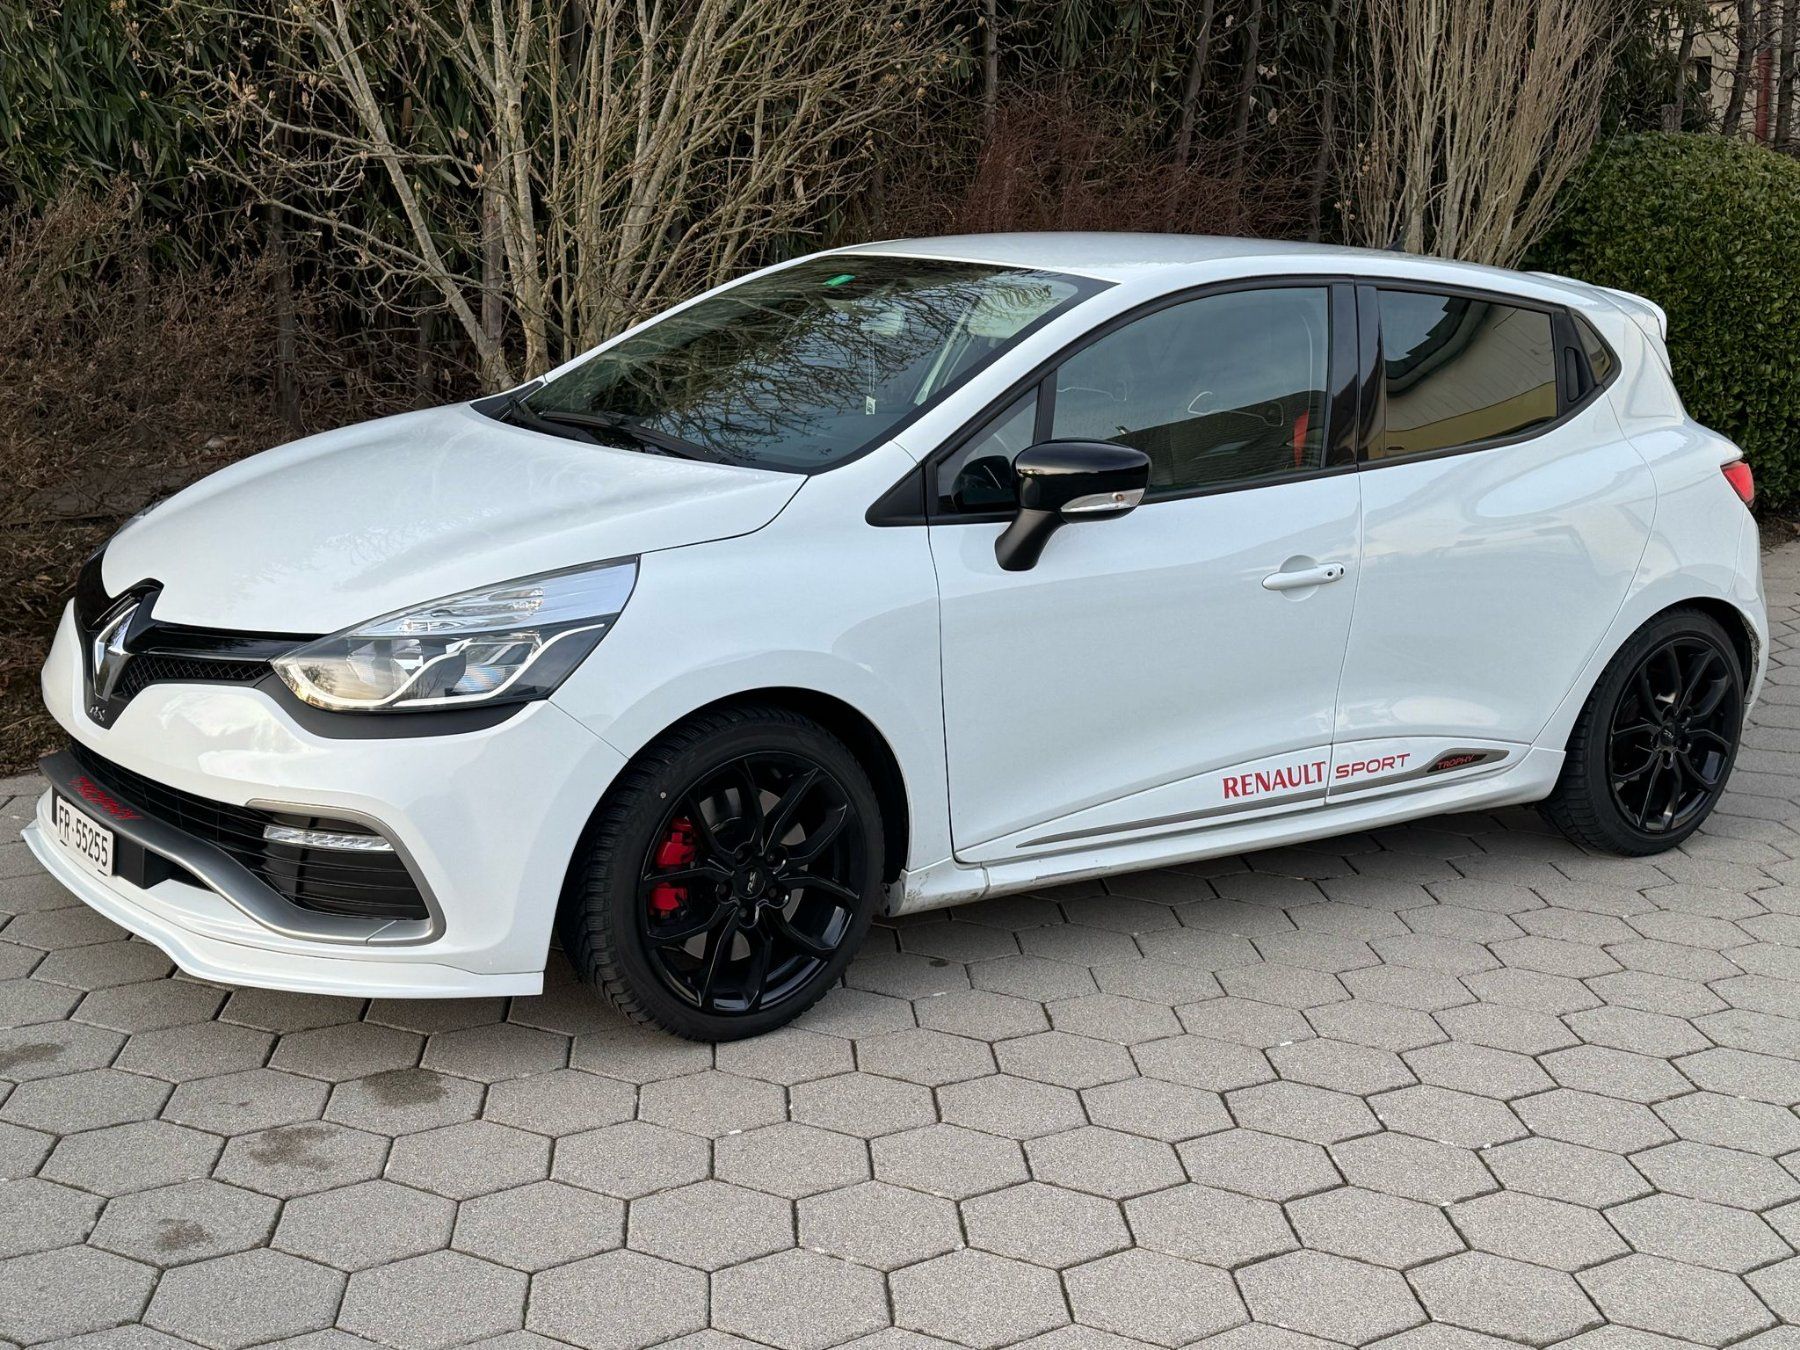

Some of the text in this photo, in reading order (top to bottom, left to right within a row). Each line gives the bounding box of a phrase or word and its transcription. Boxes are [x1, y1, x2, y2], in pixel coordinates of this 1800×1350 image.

[1222, 753, 1410, 799] RENAULT SPORT
[1436, 754, 1474, 770] TROPHY
